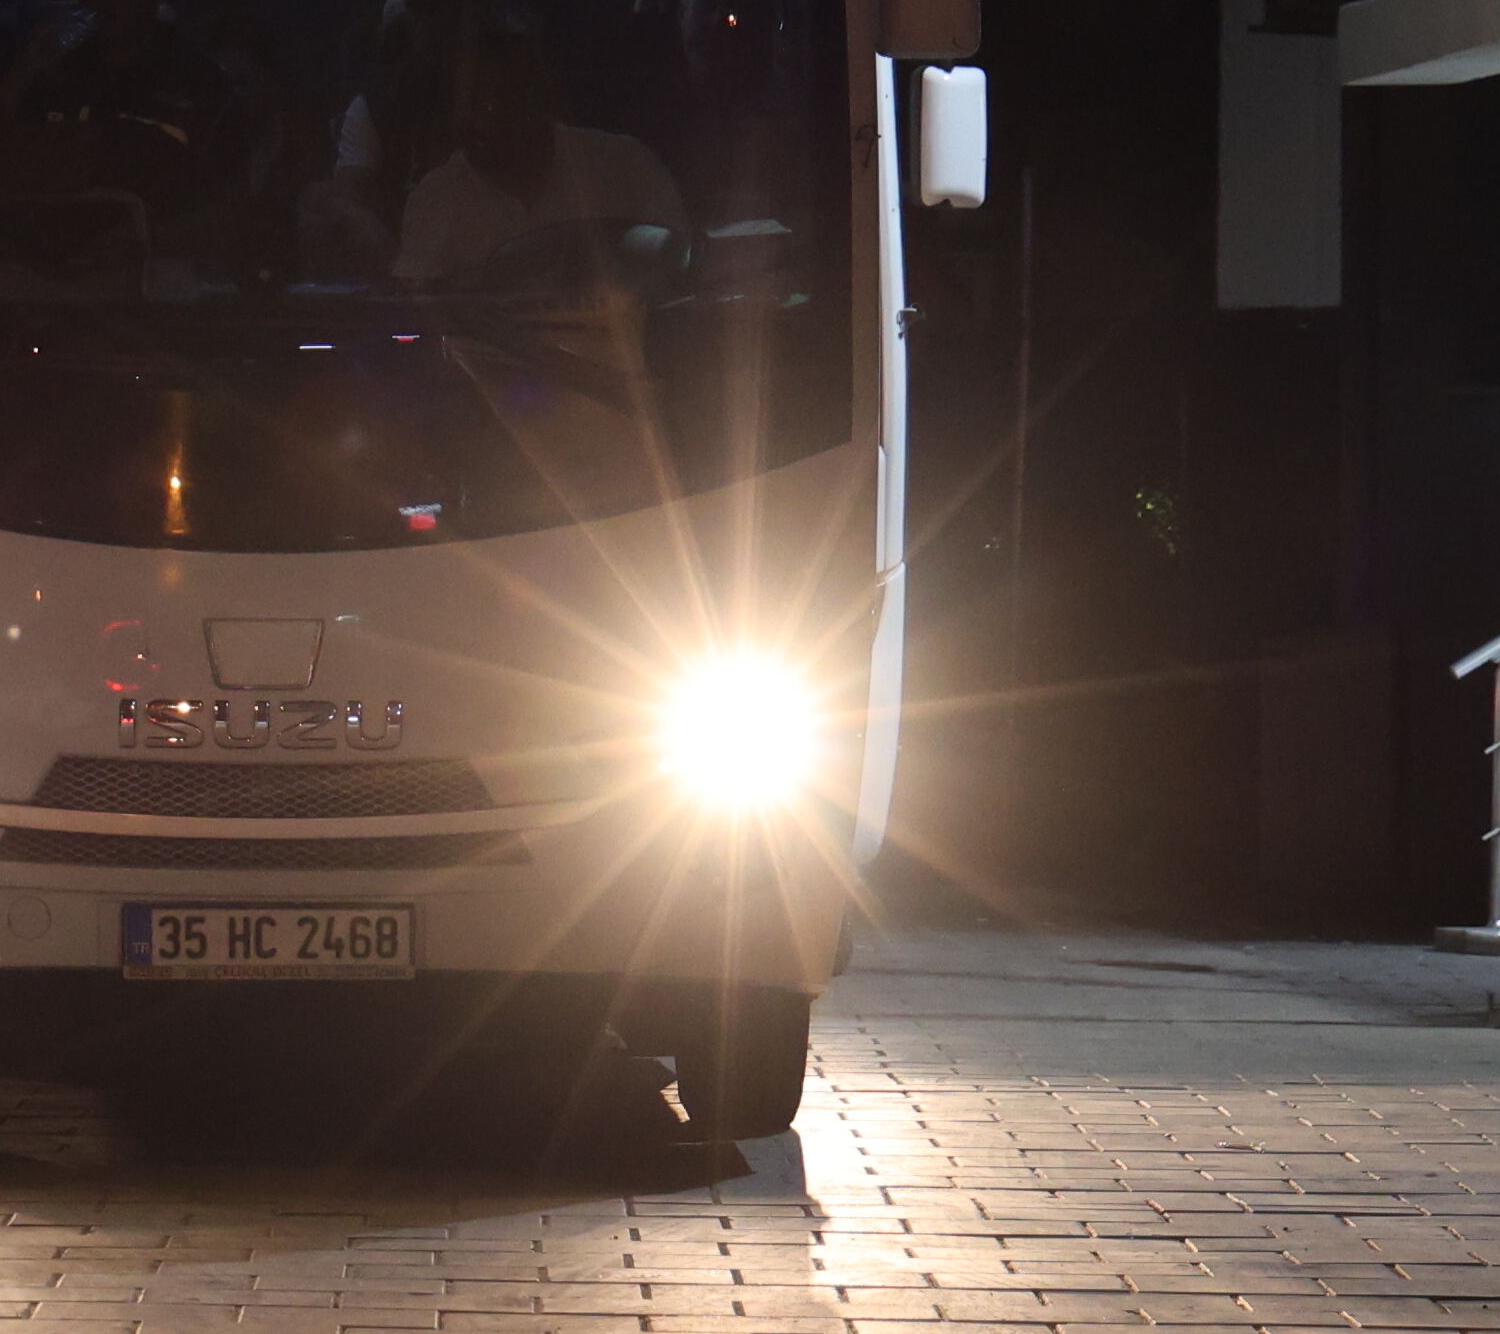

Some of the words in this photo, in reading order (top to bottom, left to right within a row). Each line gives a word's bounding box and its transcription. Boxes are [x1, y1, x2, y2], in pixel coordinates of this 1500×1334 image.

[118, 698, 404, 750] ISUZU
[157, 915, 207, 960] 35
[228, 916, 277, 960] HC
[297, 916, 398, 960] 2468
